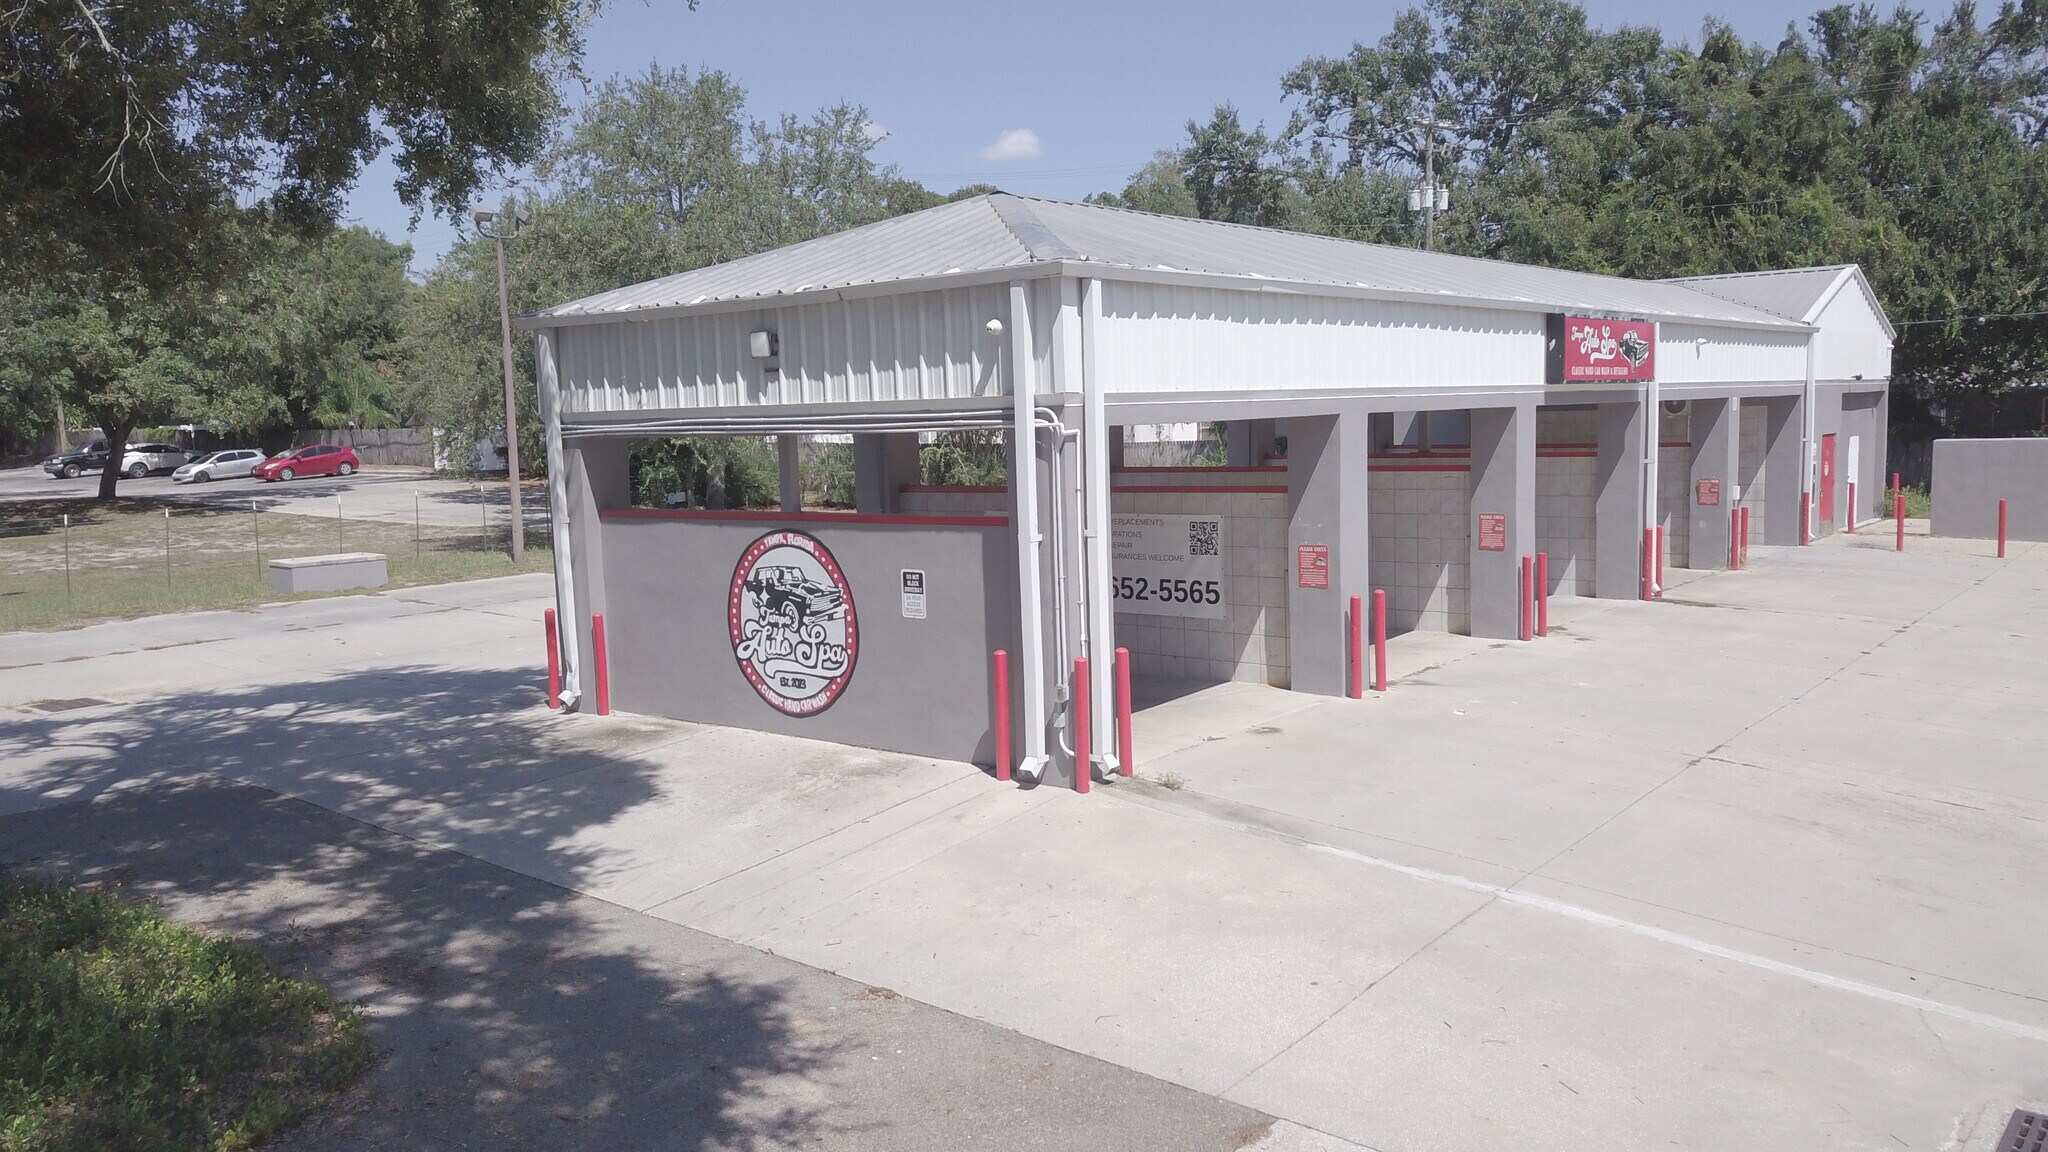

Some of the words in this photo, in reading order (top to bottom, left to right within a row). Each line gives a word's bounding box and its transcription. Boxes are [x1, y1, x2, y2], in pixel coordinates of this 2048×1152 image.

[1580, 325, 1600, 354] Auto
[1601, 325, 1617, 360] Spa
[1112, 530, 1143, 538] RATIONS
[1113, 541, 1133, 549] EPAIR
[1148, 554, 1185, 562] WELCOME
[760, 606, 792, 627] Tampa
[737, 619, 793, 662] Auto
[796, 624, 849, 677] Spa
